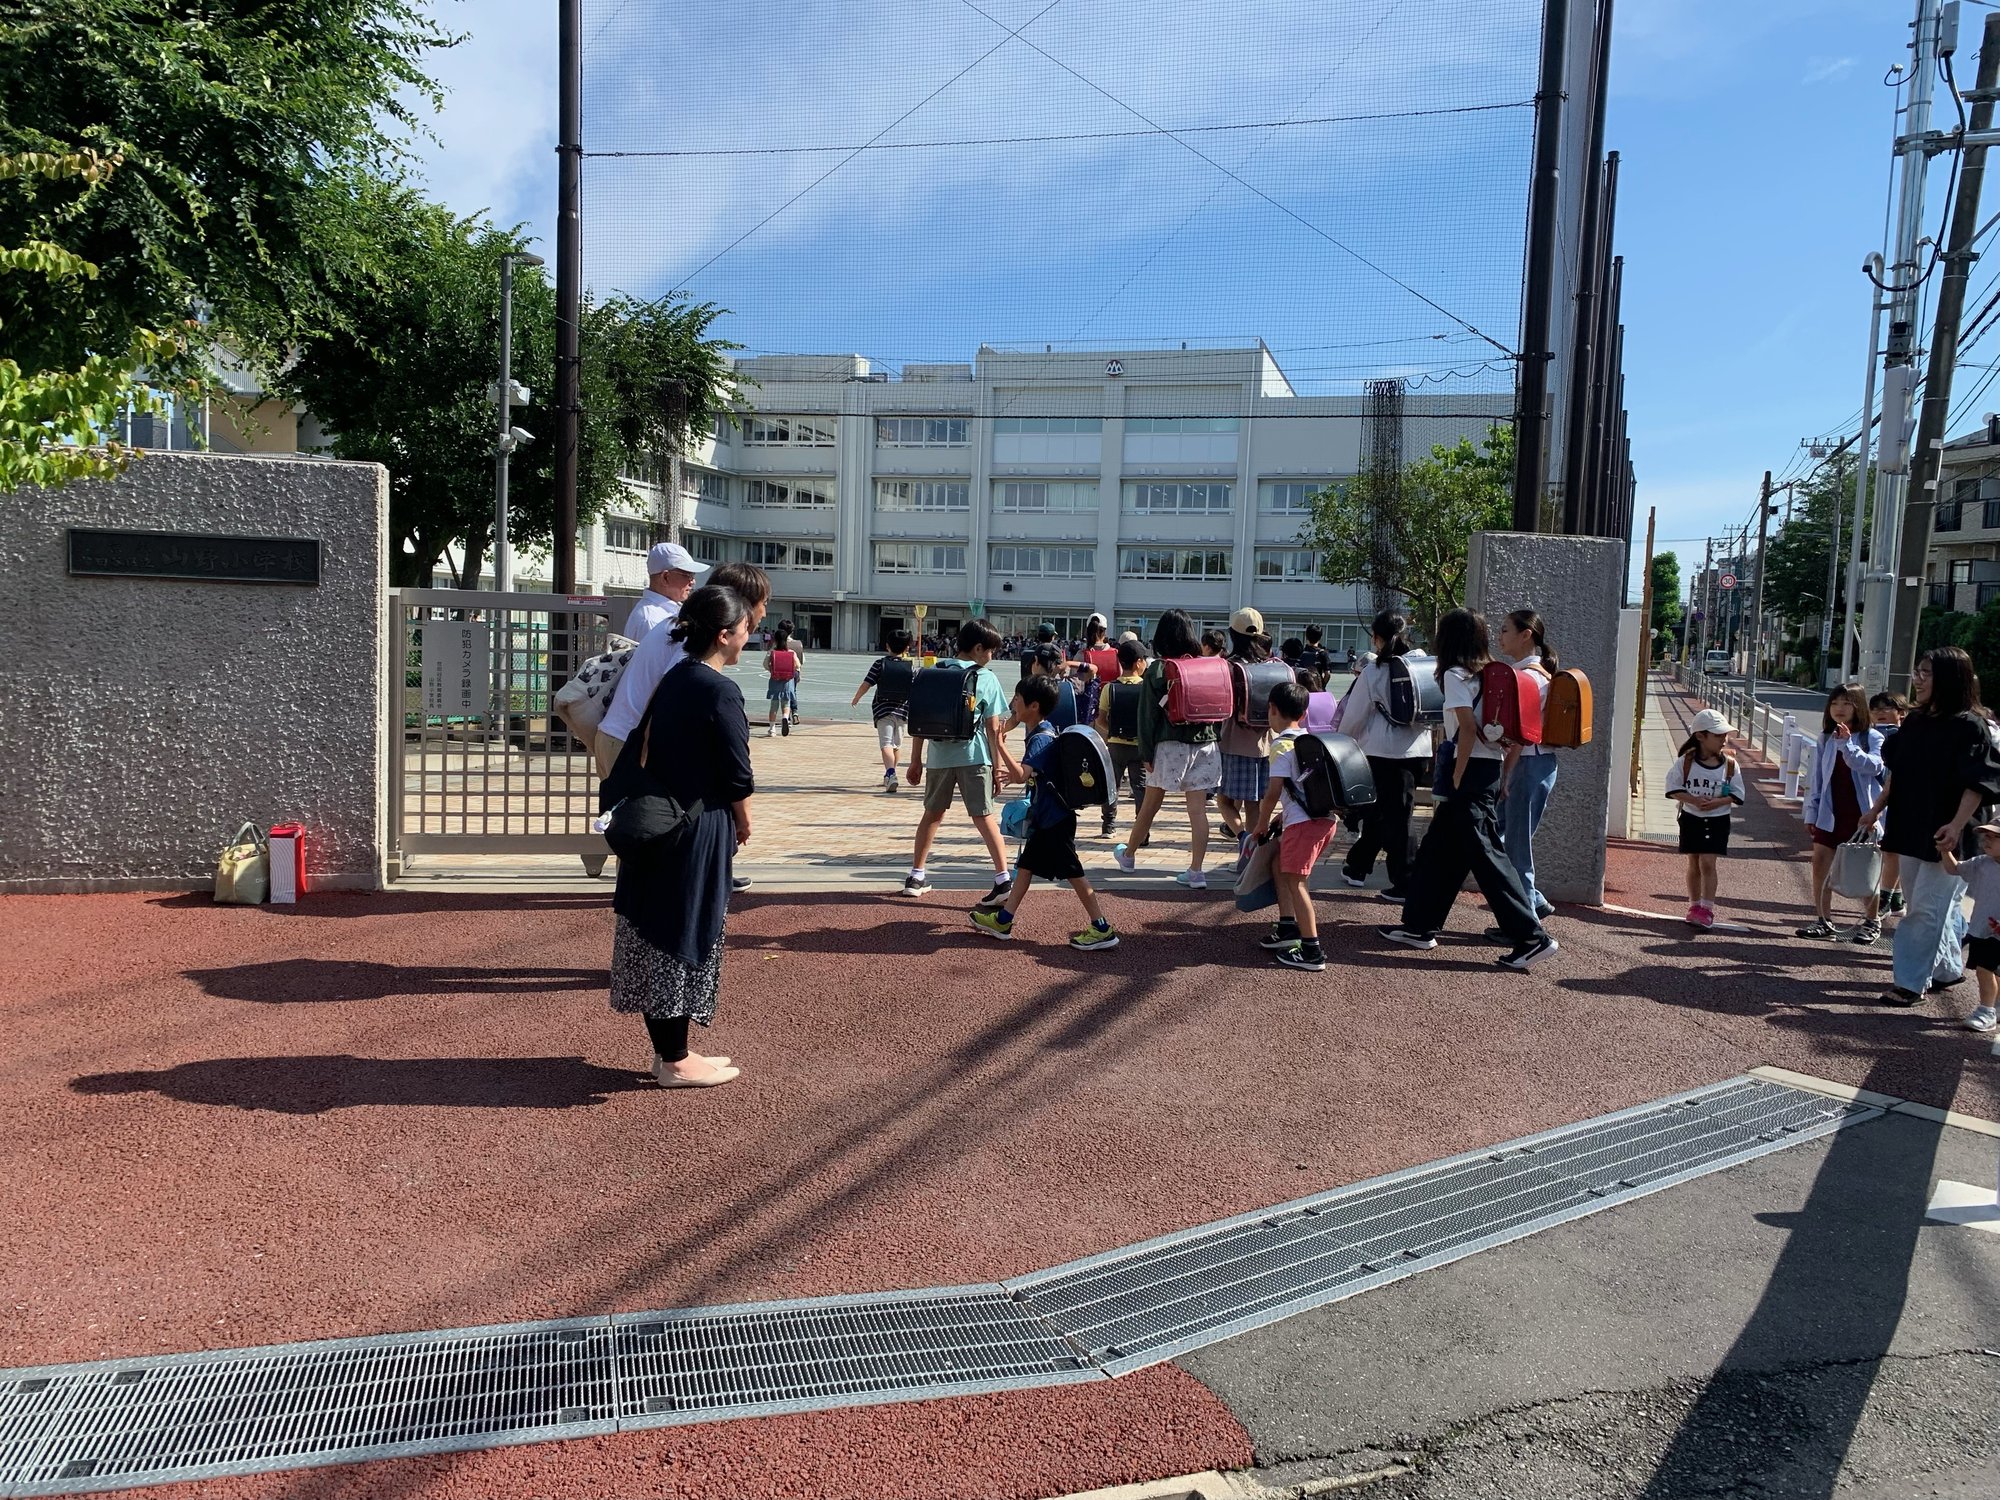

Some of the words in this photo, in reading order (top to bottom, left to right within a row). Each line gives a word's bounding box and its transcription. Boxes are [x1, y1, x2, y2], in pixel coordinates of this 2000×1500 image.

[161, 545, 312, 573] 山野小学校
[1723, 577, 1733, 585] 30
[461, 629, 472, 709] 防犯カメラ録画中
